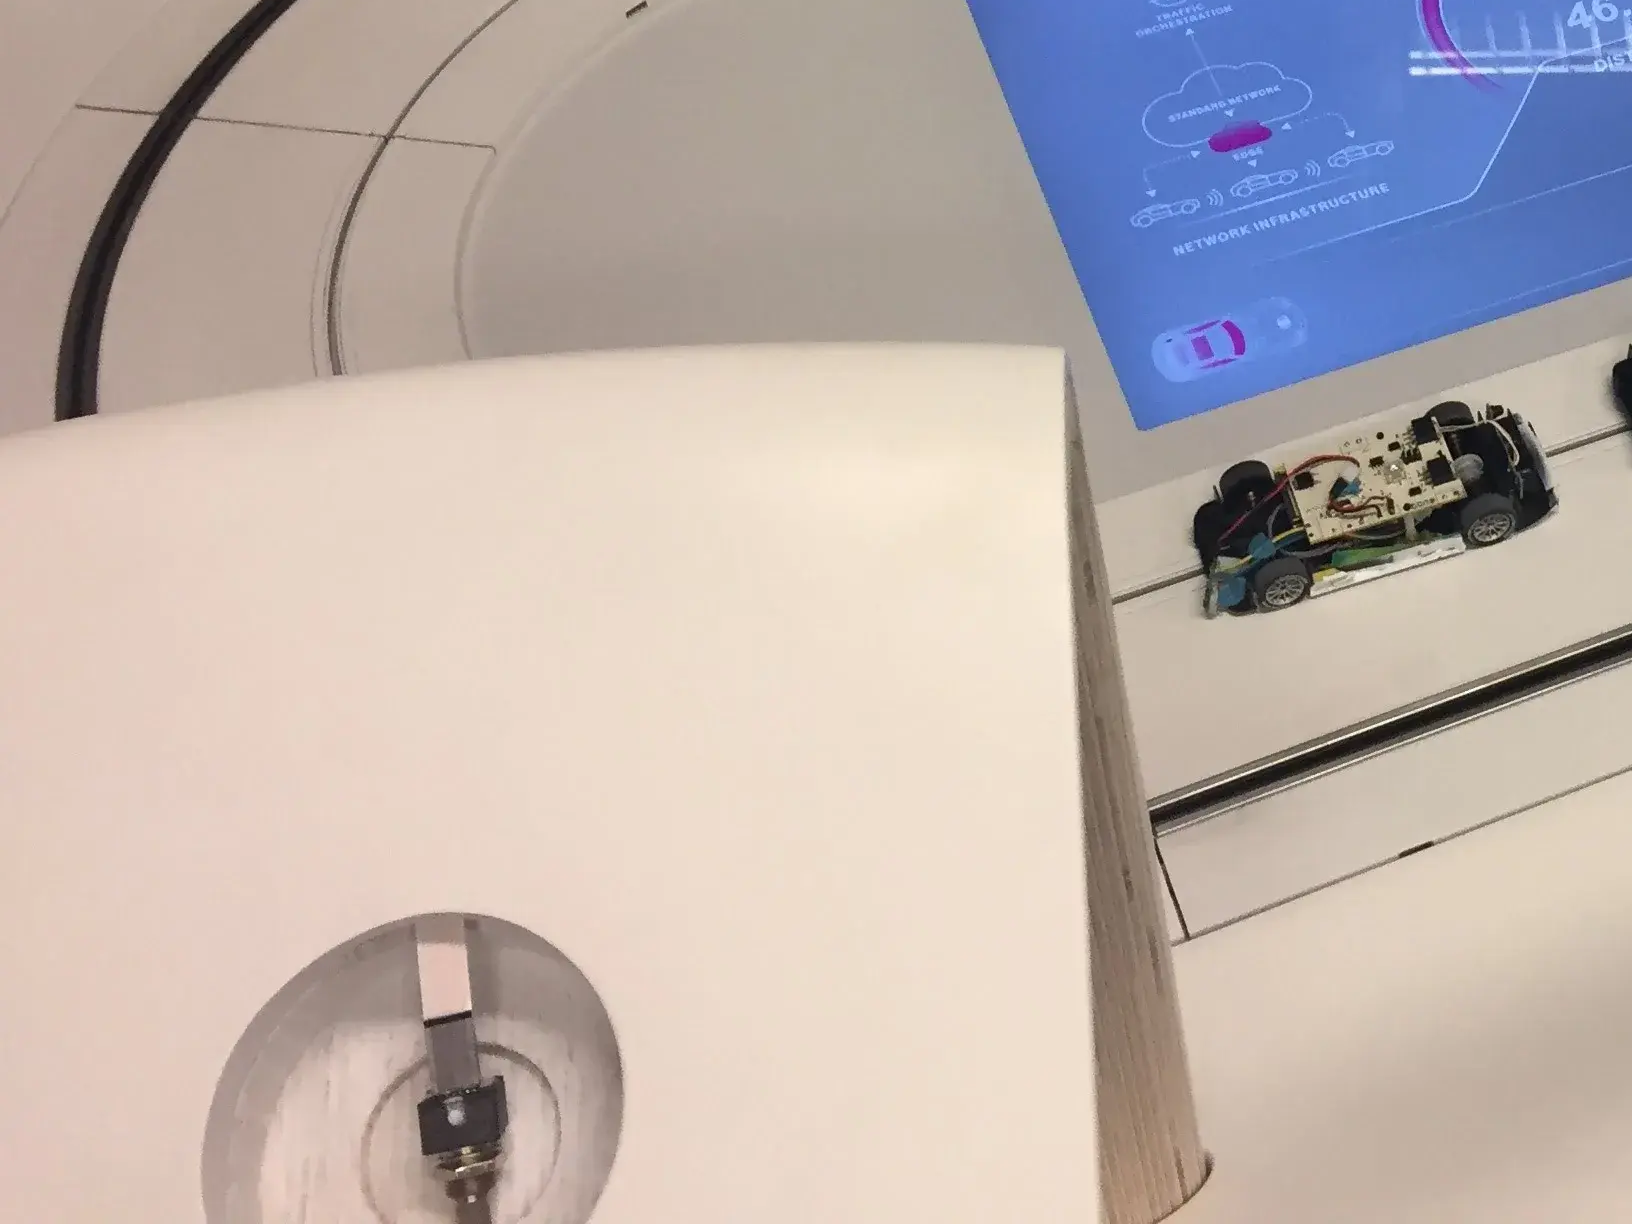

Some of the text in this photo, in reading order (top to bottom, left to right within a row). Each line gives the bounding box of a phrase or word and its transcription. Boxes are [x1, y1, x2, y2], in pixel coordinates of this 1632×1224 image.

[1135, 4, 1234, 38] ORCHESTRATION
[1156, 3, 1206, 22] TRAFFIC
[1167, 84, 1282, 123] STANDARD NETWORK
[1172, 182, 1390, 256] NETWORK INFRASTRUCTURE
